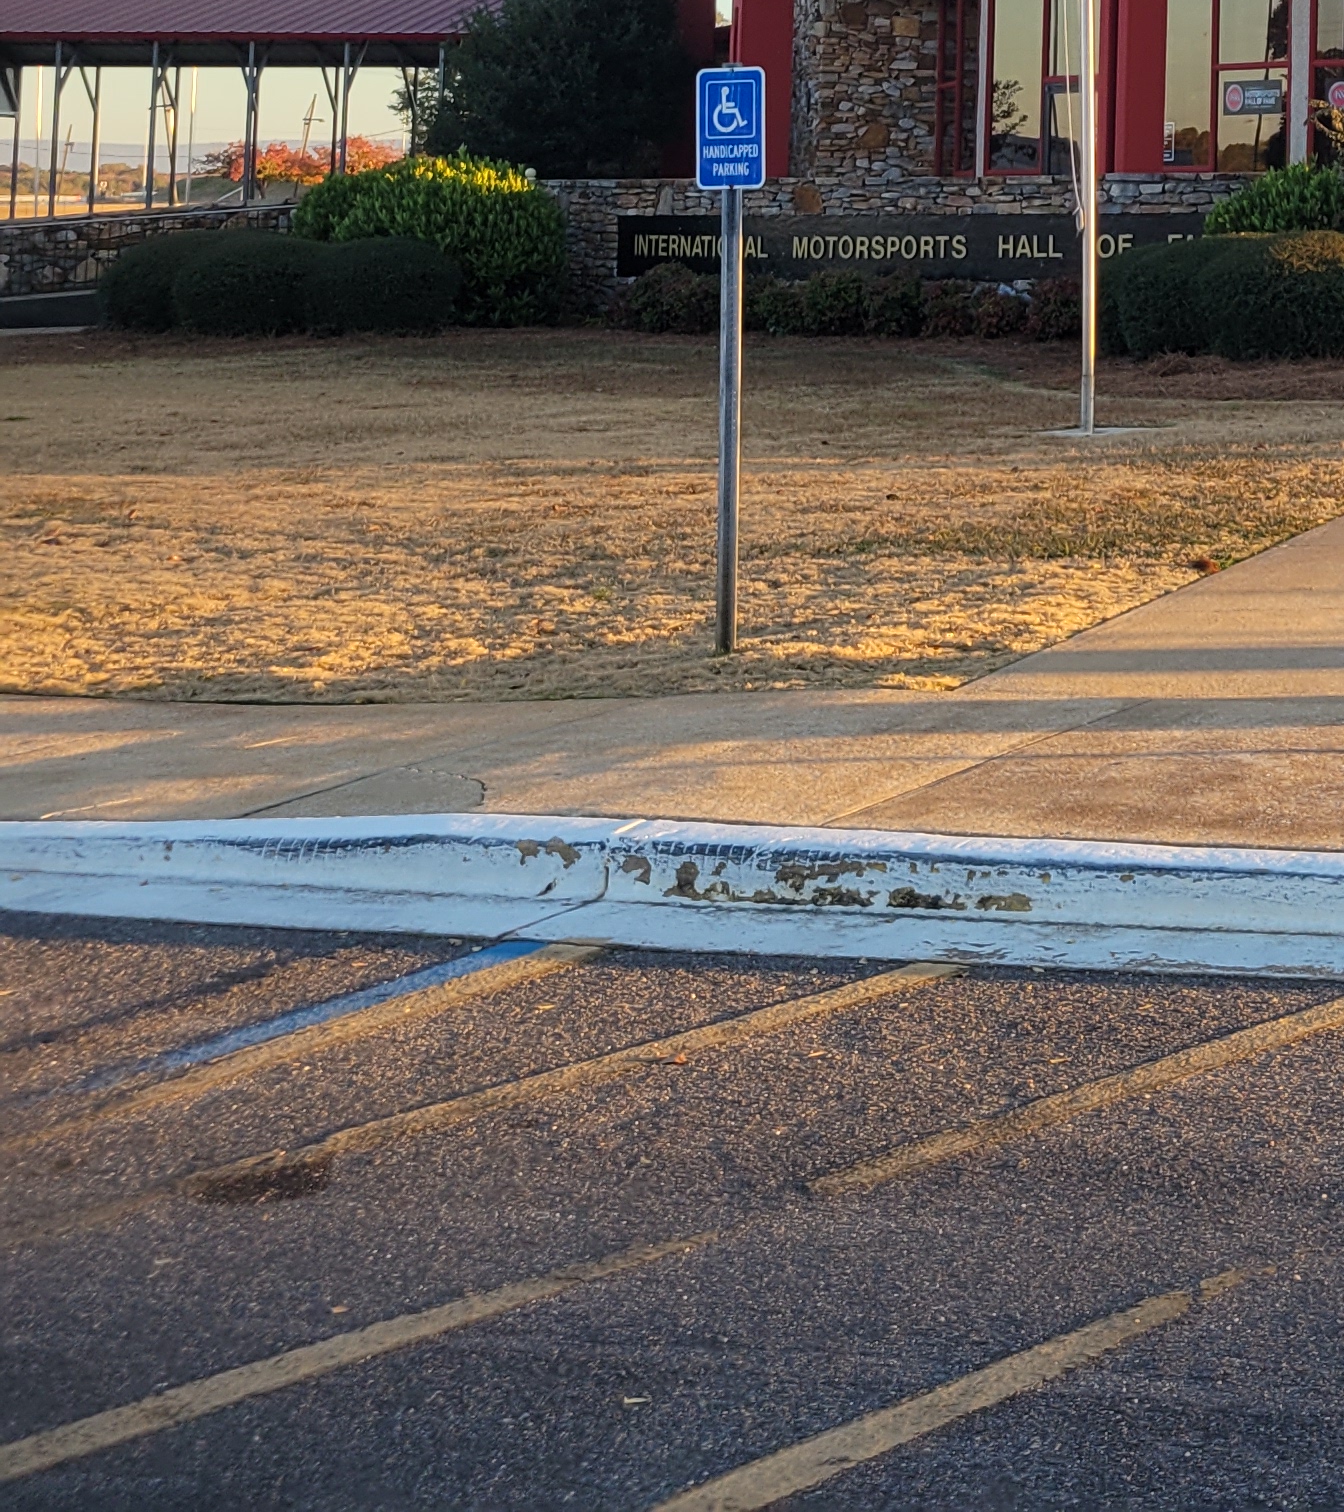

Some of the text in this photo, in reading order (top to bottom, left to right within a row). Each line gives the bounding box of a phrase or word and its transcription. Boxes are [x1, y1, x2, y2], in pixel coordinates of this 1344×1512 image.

[703, 144, 758, 158] HANDICAPPED
[713, 162, 749, 176] PARKING
[634, 234, 1133, 259] INTERNATIAL MOTORSPORTS HALL OF
